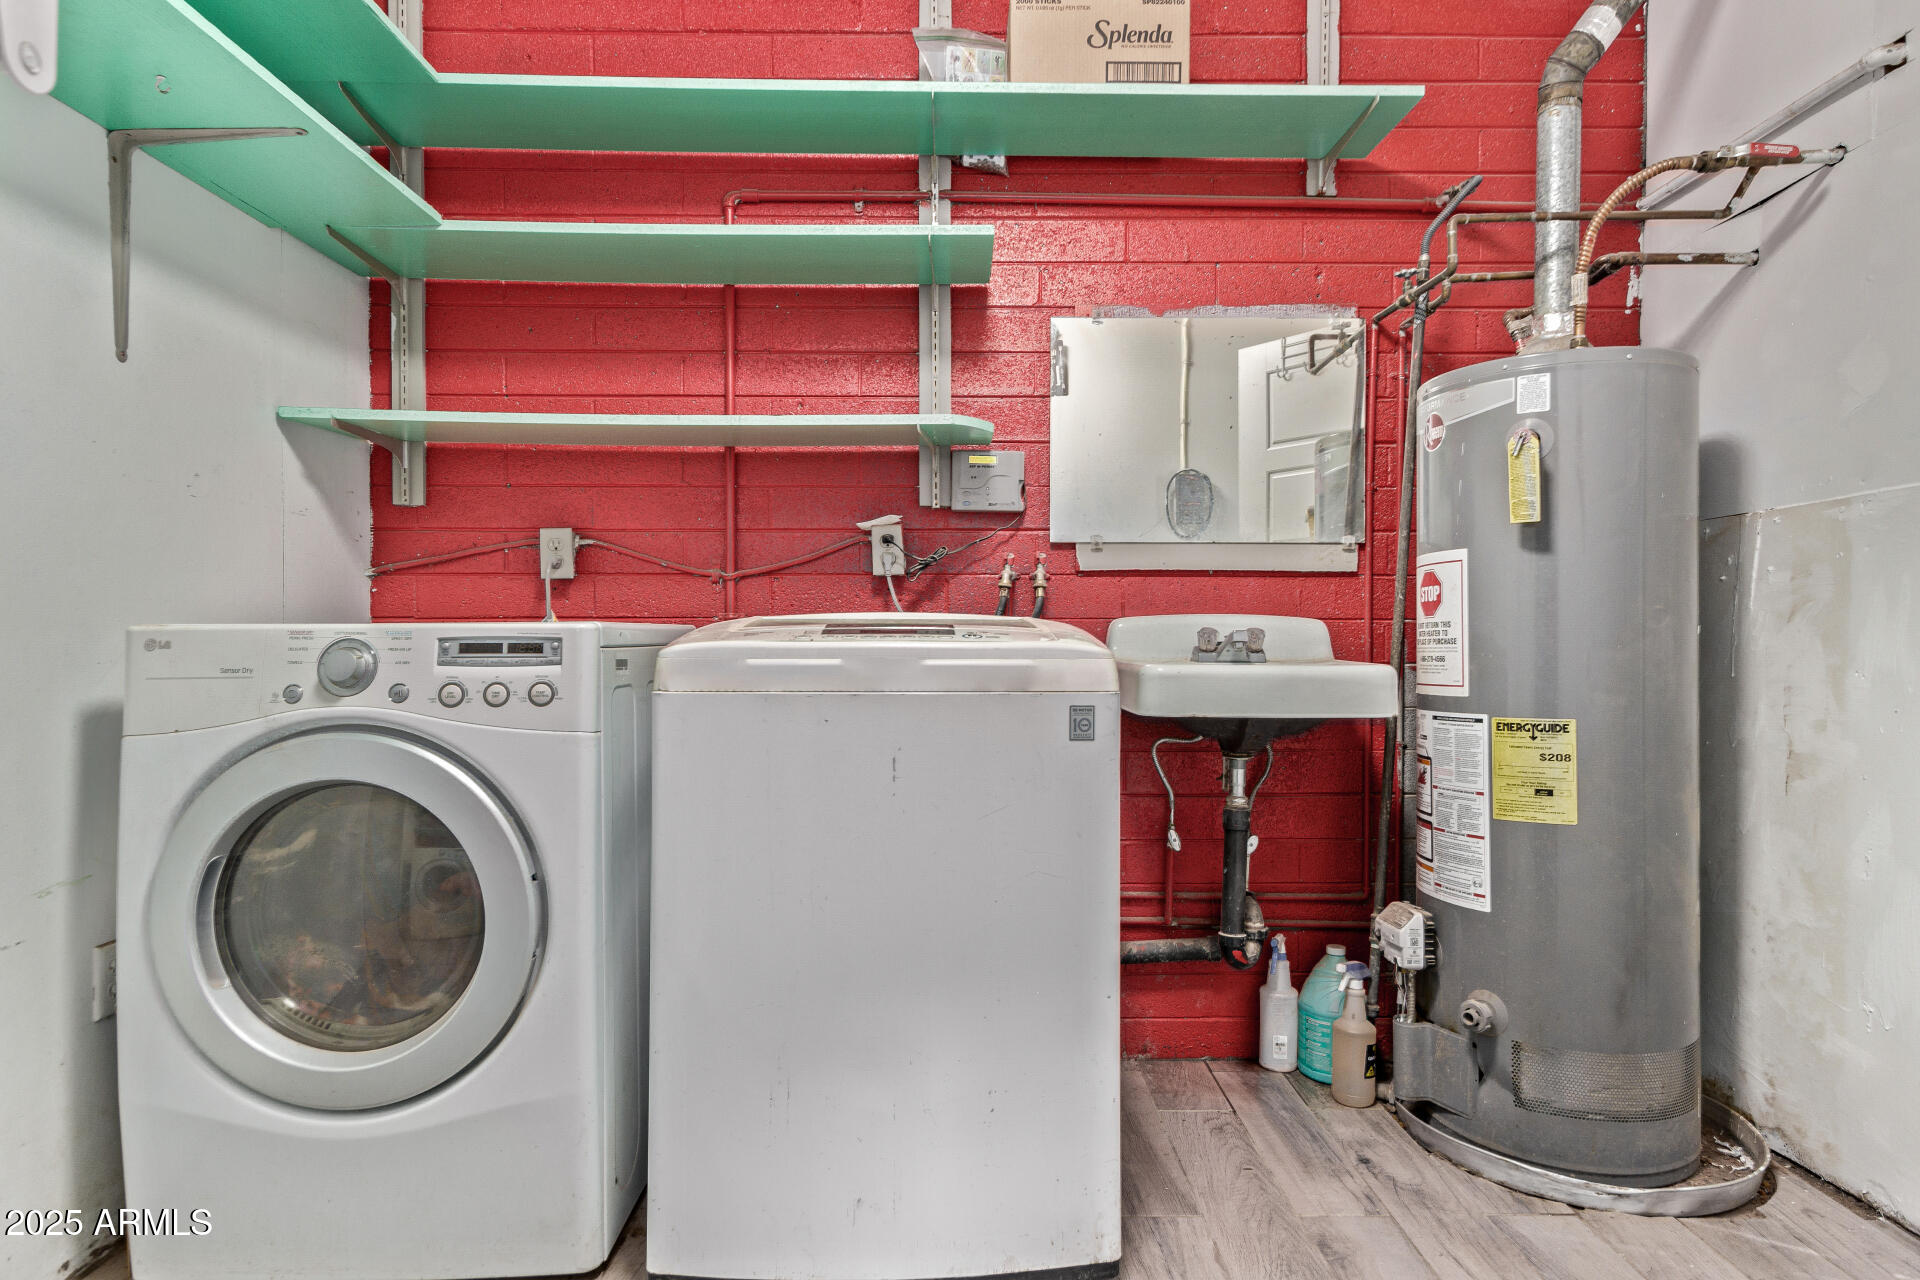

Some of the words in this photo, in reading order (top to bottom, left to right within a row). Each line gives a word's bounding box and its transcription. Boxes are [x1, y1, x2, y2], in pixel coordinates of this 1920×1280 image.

[1087, 19, 1173, 49] Splenda
[1420, 585, 1440, 603] STOP
[1440, 620, 1452, 628] THIS
[1441, 629, 1448, 637] TO
[158, 640, 172, 650] LG
[1432, 637, 1457, 645] PURCHASE
[241, 667, 254, 675] Dry
[1495, 721, 1570, 734] ENERGYGUIDE
[1539, 753, 1572, 763] $208
